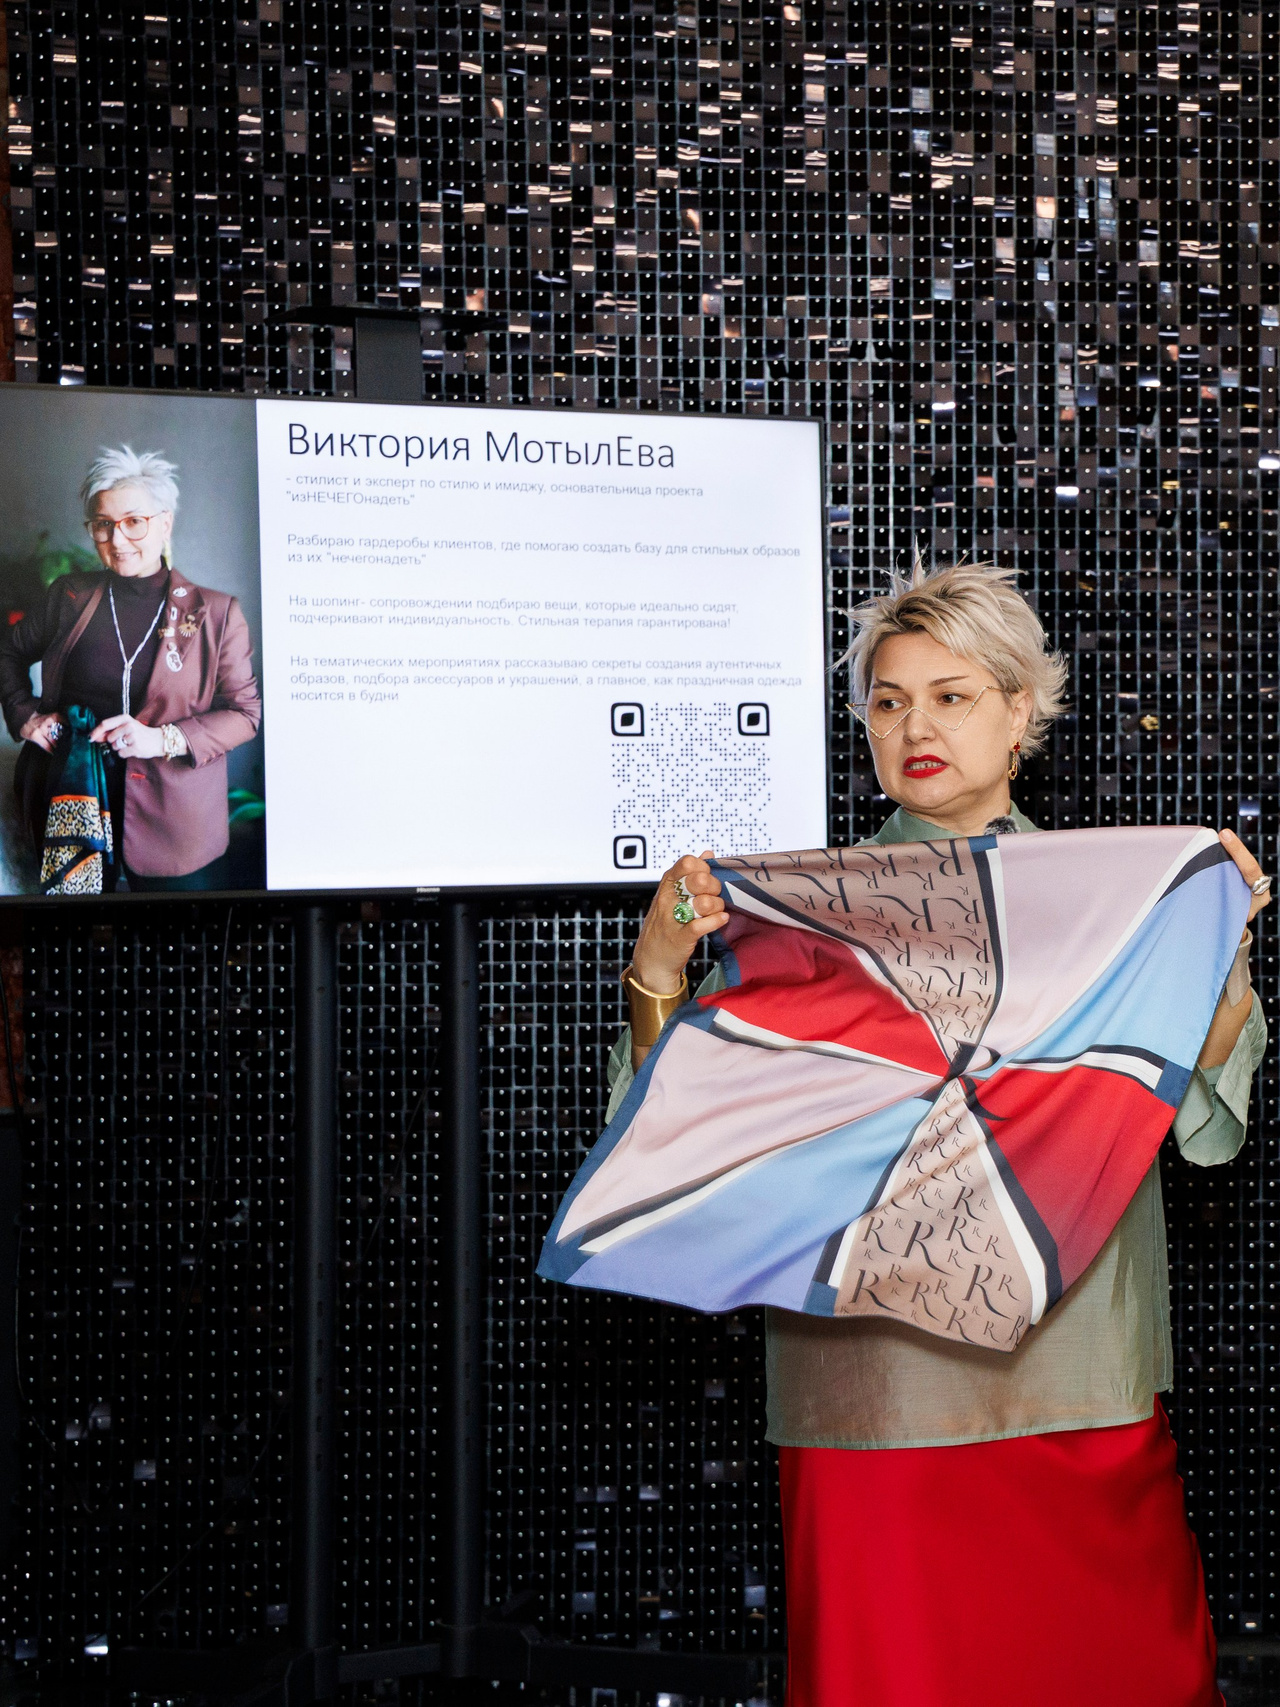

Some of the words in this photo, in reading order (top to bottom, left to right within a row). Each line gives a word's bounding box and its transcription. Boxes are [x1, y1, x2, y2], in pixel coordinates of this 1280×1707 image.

[288, 423, 470, 467] Виктория
[486, 431, 674, 467] МотылЕва
[285, 490, 416, 507] "изНЕЧЕГОнадеть"
[295, 475, 349, 489] стилист
[352, 477, 361, 488] и
[365, 477, 416, 491] эксперт
[419, 479, 436, 489] по
[438, 479, 480, 491] стилю
[483, 481, 492, 491] и
[494, 481, 547, 496] имиджу,
[549, 483, 652, 497] основательница
[655, 486, 704, 499] проекта
[287, 533, 355, 550] Разбираю
[358, 536, 430, 551] гардеробы
[433, 539, 497, 552] клиентов,
[500, 541, 522, 552] где
[524, 541, 580, 553] помогаю
[582, 543, 632, 555] создать
[634, 541, 663, 557] базу
[664, 544, 689, 556] для
[691, 545, 749, 556] стильных
[751, 544, 801, 559] образов
[287, 553, 303, 563] из
[306, 553, 323, 563] их
[326, 551, 427, 566] "нечегонадеть"
[288, 594, 308, 607] На
[311, 597, 366, 607] шопинг-
[369, 598, 473, 611] сопровождении
[476, 597, 541, 612] подбираю
[544, 600, 581, 612] вещи,
[585, 601, 637, 614] которые
[639, 602, 700, 613] идеально
[702, 603, 739, 614] сидят,
[289, 613, 384, 627] подчеркивают
[517, 614, 580, 627] Стильная
[583, 617, 634, 629] терапия
[636, 617, 731, 631] гарантирована!
[290, 655, 309, 667] На
[312, 657, 404, 668] тематических
[407, 658, 501, 670] мероприятиях
[504, 658, 589, 671] рассказываю
[591, 659, 642, 672] секреты
[645, 659, 702, 671] создания
[705, 660, 782, 673] аутентичных
[290, 671, 349, 687] образов,
[353, 672, 410, 687] подбора
[412, 675, 494, 688] аксессуаров
[497, 676, 506, 685] и
[509, 674, 582, 688] украшений,
[585, 676, 594, 686] а
[597, 676, 650, 687] главное,
[653, 676, 674, 686] как
[676, 676, 755, 688] праздничная
[757, 676, 803, 688] одежда
[290, 691, 345, 702] носится
[348, 691, 356, 702] в
[359, 688, 399, 705] будни
[951, 1185, 985, 1222] R
[861, 1216, 897, 1255] R
[901, 1220, 954, 1276] R
[945, 1215, 980, 1255] R
[848, 1268, 905, 1314] R
[910, 1281, 941, 1322] R
[961, 1263, 1012, 1320] R
[946, 1307, 977, 1344] R
